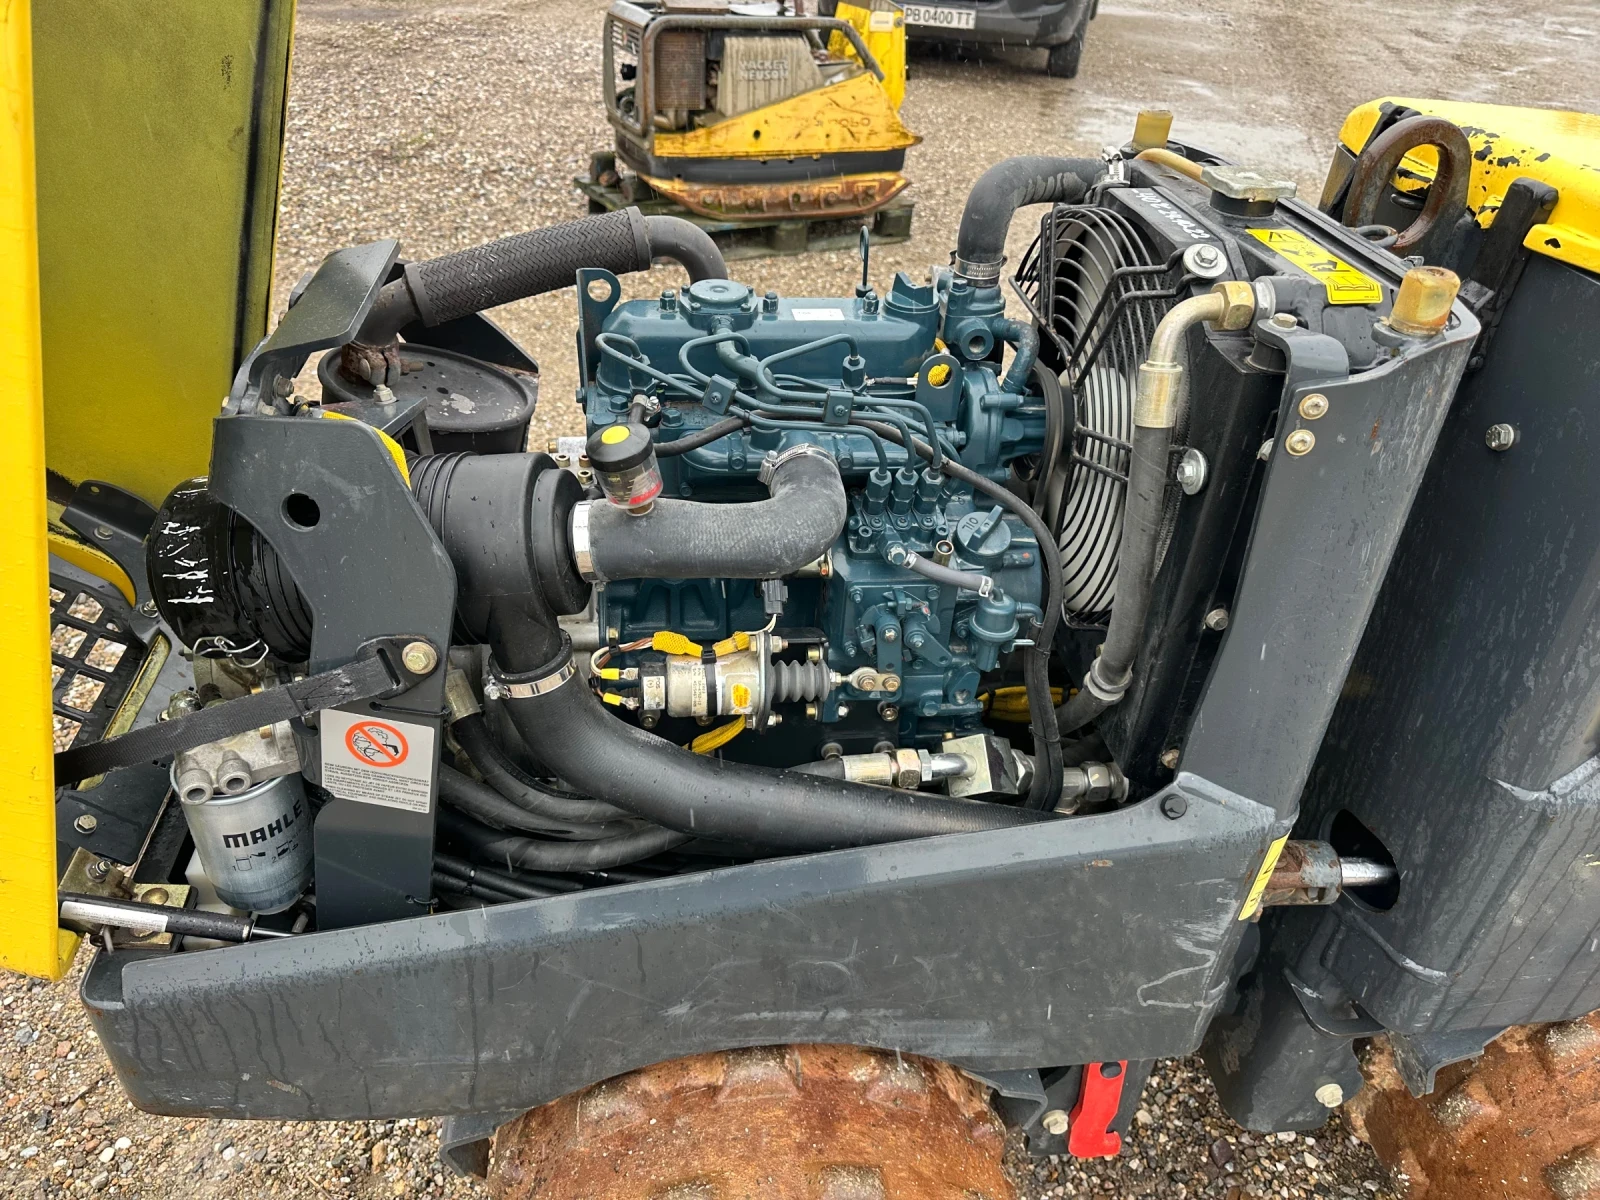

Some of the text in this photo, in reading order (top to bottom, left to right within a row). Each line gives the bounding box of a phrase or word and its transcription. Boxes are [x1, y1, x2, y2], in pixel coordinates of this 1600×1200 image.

[905, 7, 973, 26] PB 0400 TT
[961, 517, 979, 531] OIL
[222, 799, 303, 848] MAHLE
